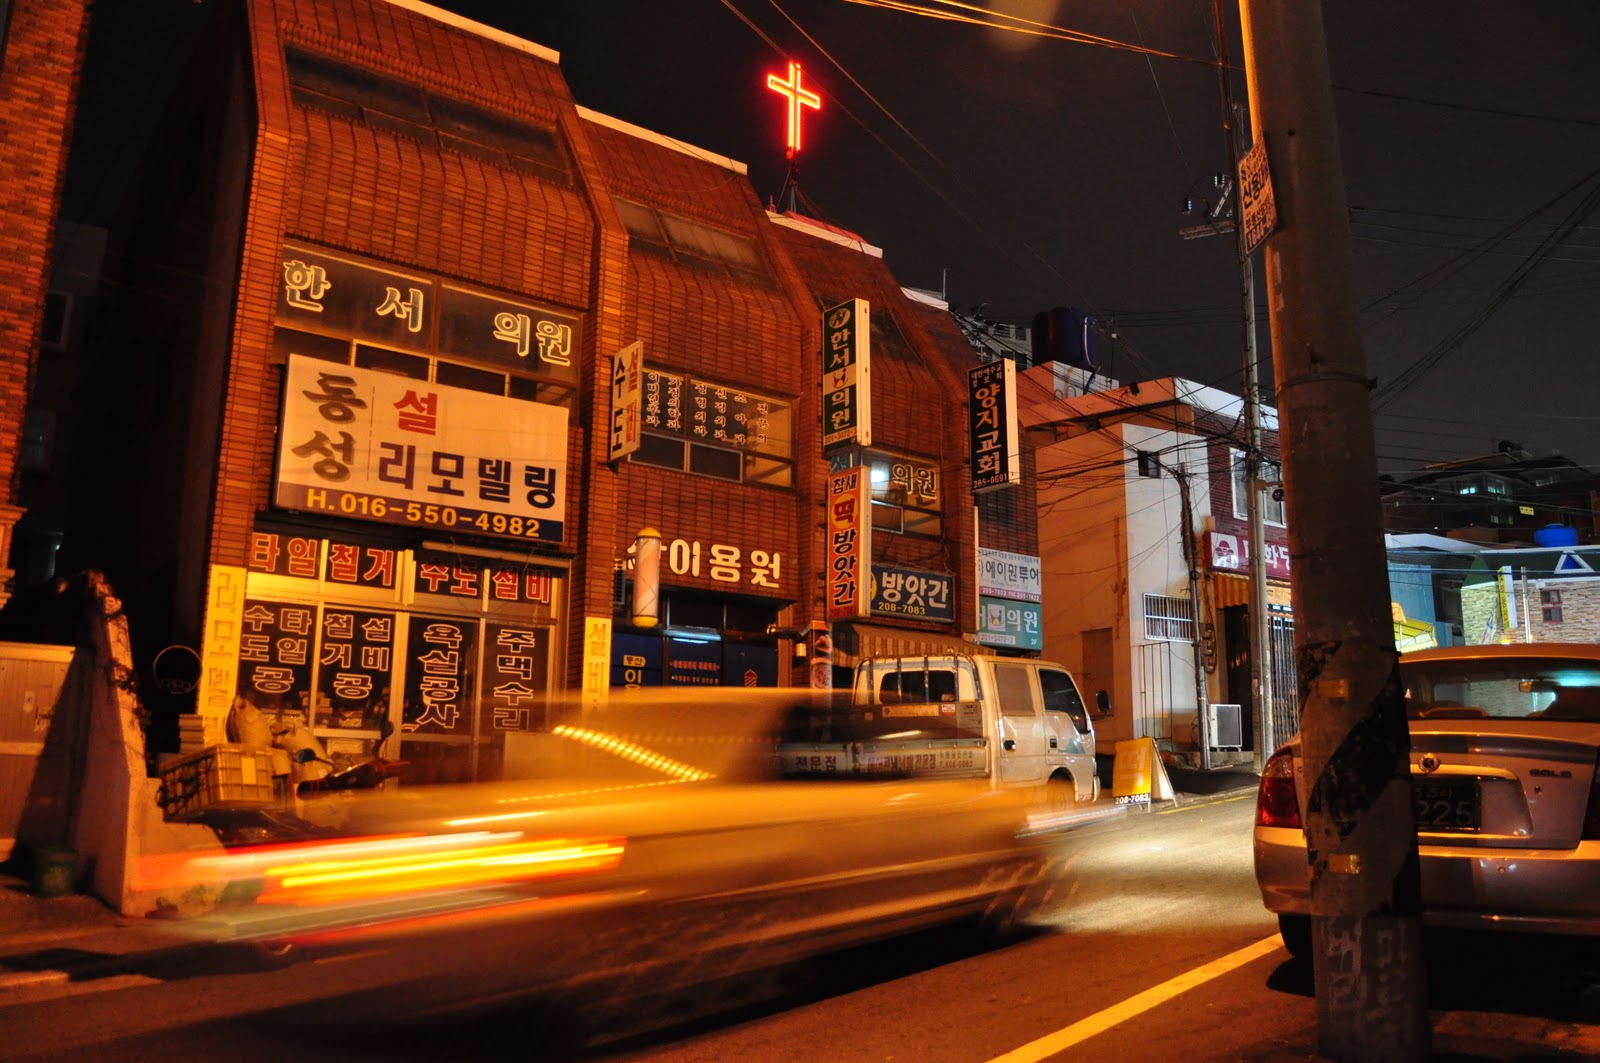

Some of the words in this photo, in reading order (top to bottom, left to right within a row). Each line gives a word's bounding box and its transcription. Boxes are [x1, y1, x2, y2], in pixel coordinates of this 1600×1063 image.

[291, 372, 368, 483] 동성
[975, 384, 1002, 475] 양지교회
[378, 441, 557, 509] 리모델링
[832, 473, 858, 495] 참새
[892, 464, 937, 499] 의원
[973, 471, 1008, 489] 265-0691
[249, 532, 318, 577] 타일
[329, 544, 394, 587] 철거
[420, 558, 478, 597] 수도
[493, 565, 551, 604] 설비
[882, 570, 949, 609] 방앗간
[878, 601, 925, 616] 208-7083
[1114, 793, 1150, 805] 208-7083
